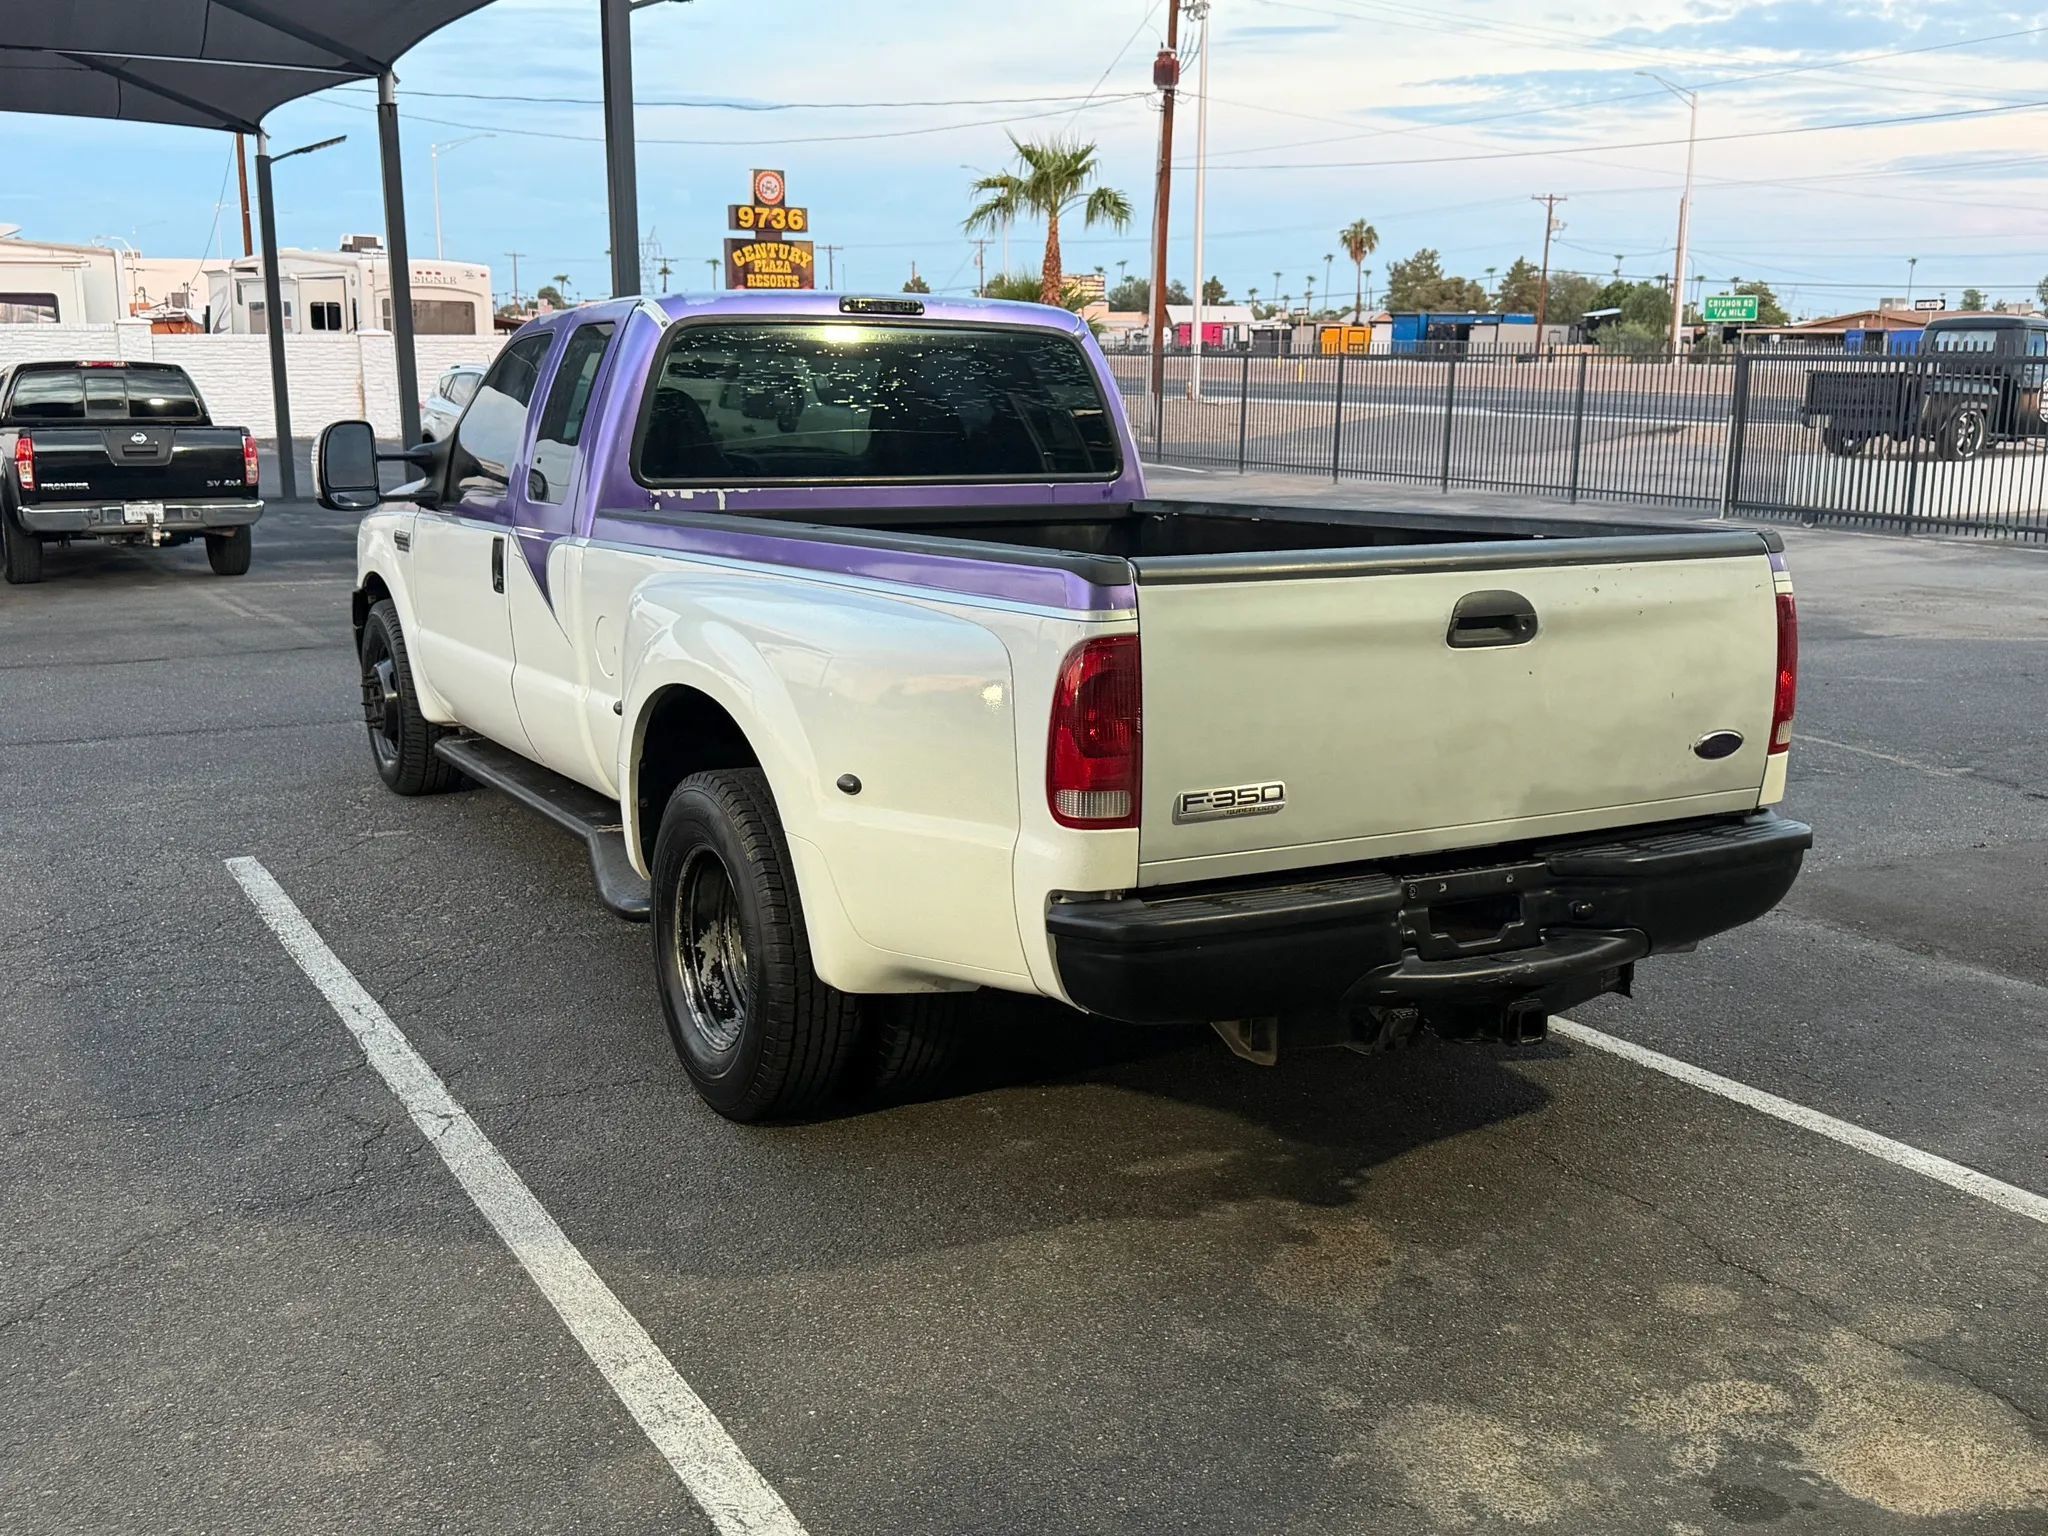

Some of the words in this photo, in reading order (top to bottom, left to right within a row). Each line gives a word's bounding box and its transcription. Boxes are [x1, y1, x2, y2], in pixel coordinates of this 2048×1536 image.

[738, 206, 804, 231] 9736
[732, 242, 812, 269] CENTURY
[754, 260, 791, 274] PLAZA
[411, 275, 457, 285] SIGNER
[747, 275, 800, 288] RESORTS
[1708, 299, 1741, 308] CRISMON
[1743, 299, 1753, 307] RD
[1714, 308, 1727, 317] 1/4
[1729, 308, 1746, 316] MILE
[40, 481, 91, 491] FRONTIER
[206, 479, 220, 487] SV
[1182, 784, 1284, 812] F-350
